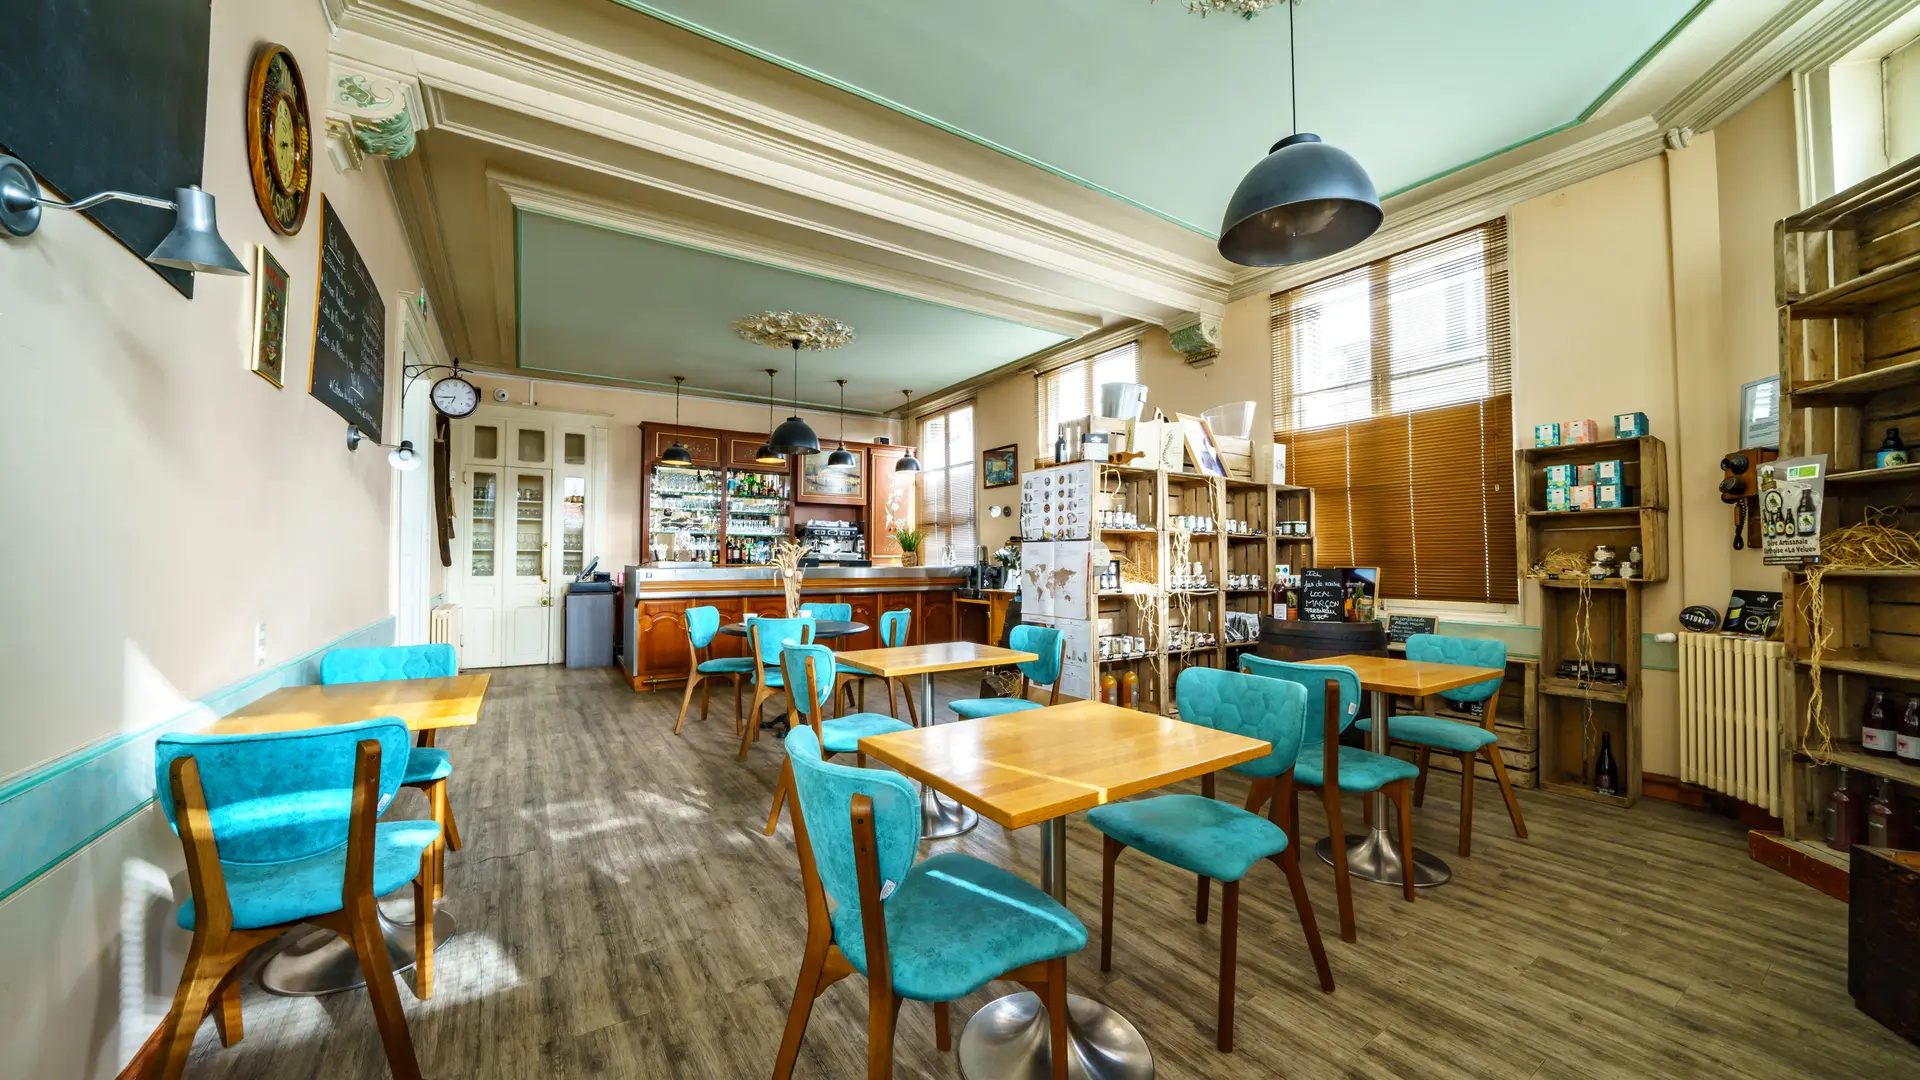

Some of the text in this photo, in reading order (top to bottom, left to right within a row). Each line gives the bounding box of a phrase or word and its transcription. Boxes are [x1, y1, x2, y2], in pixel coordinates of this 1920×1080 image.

[1315, 579, 1324, 587] de
[1309, 590, 1334, 598] LOCAL
[1685, 613, 1710, 625] STURIA
